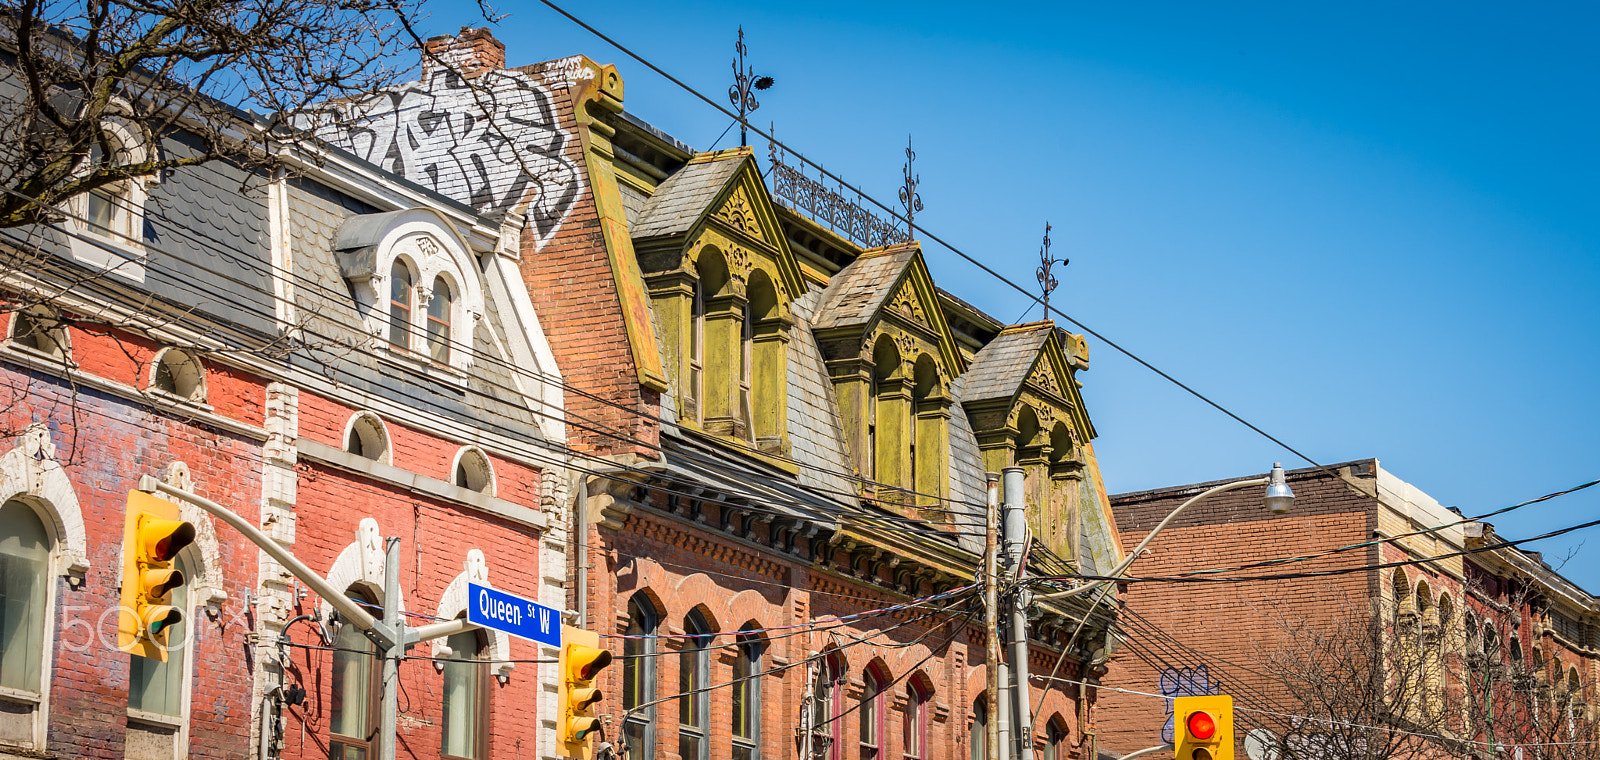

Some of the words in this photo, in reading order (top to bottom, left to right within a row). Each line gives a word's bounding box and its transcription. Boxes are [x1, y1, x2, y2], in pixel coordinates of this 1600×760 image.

[479, 589, 521, 626] Queen
[527, 603, 536, 619] St
[539, 607, 550, 635] W
